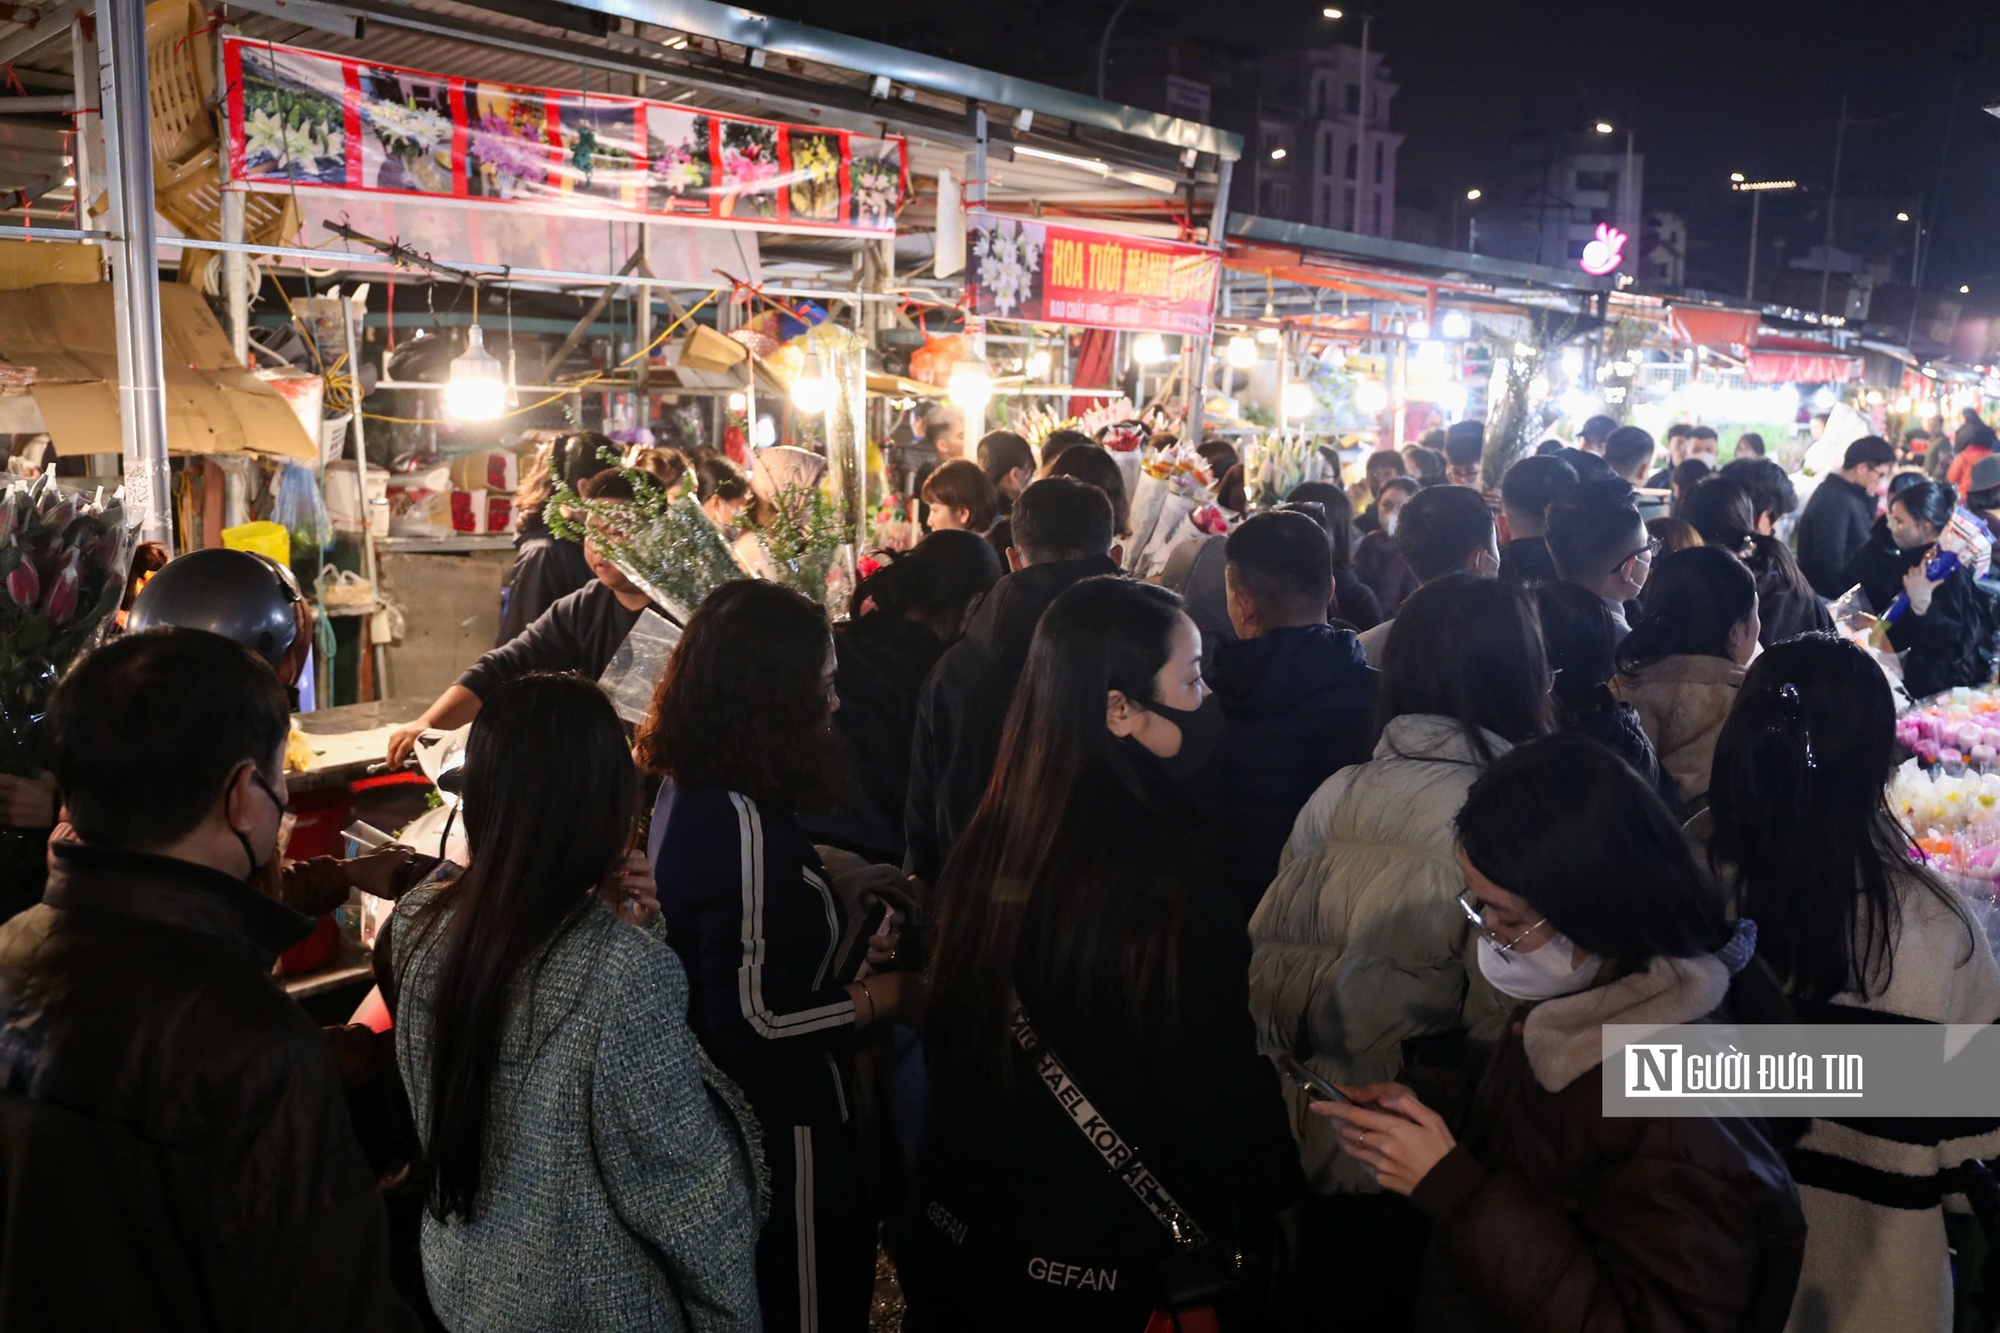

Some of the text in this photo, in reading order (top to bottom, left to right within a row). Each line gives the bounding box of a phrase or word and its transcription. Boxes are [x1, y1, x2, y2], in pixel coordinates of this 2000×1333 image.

[1051, 238, 1084, 289] HOA
[1088, 238, 1123, 292] TƯƠI
[927, 1200, 969, 1245] GEFAN
[1027, 1256, 1118, 1291] GEFAN
